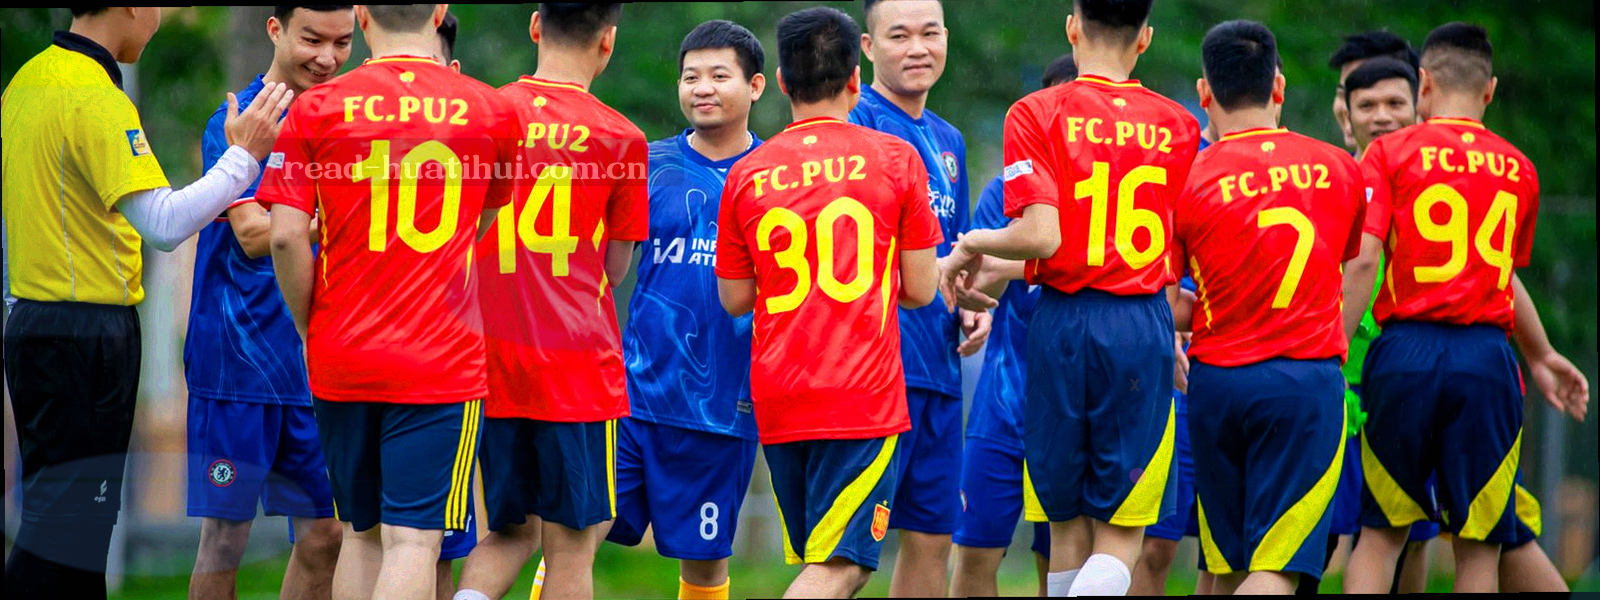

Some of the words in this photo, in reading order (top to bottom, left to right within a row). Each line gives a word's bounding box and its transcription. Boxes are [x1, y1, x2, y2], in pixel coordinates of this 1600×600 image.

[343, 95, 469, 126] FC.PU2
[517, 122, 591, 153] .PU2
[1066, 116, 1172, 154] FC.PU2
[752, 154, 867, 198] FC.PU2
[1218, 163, 1331, 203] FC.PU2
[1420, 146, 1520, 182] FC.PU2
[351, 139, 463, 254] 10
[1074, 161, 1168, 270] 16
[756, 196, 875, 315] 30
[1257, 206, 1315, 309] 7
[1413, 183, 1518, 291] 94
[700, 502, 719, 540] 8
